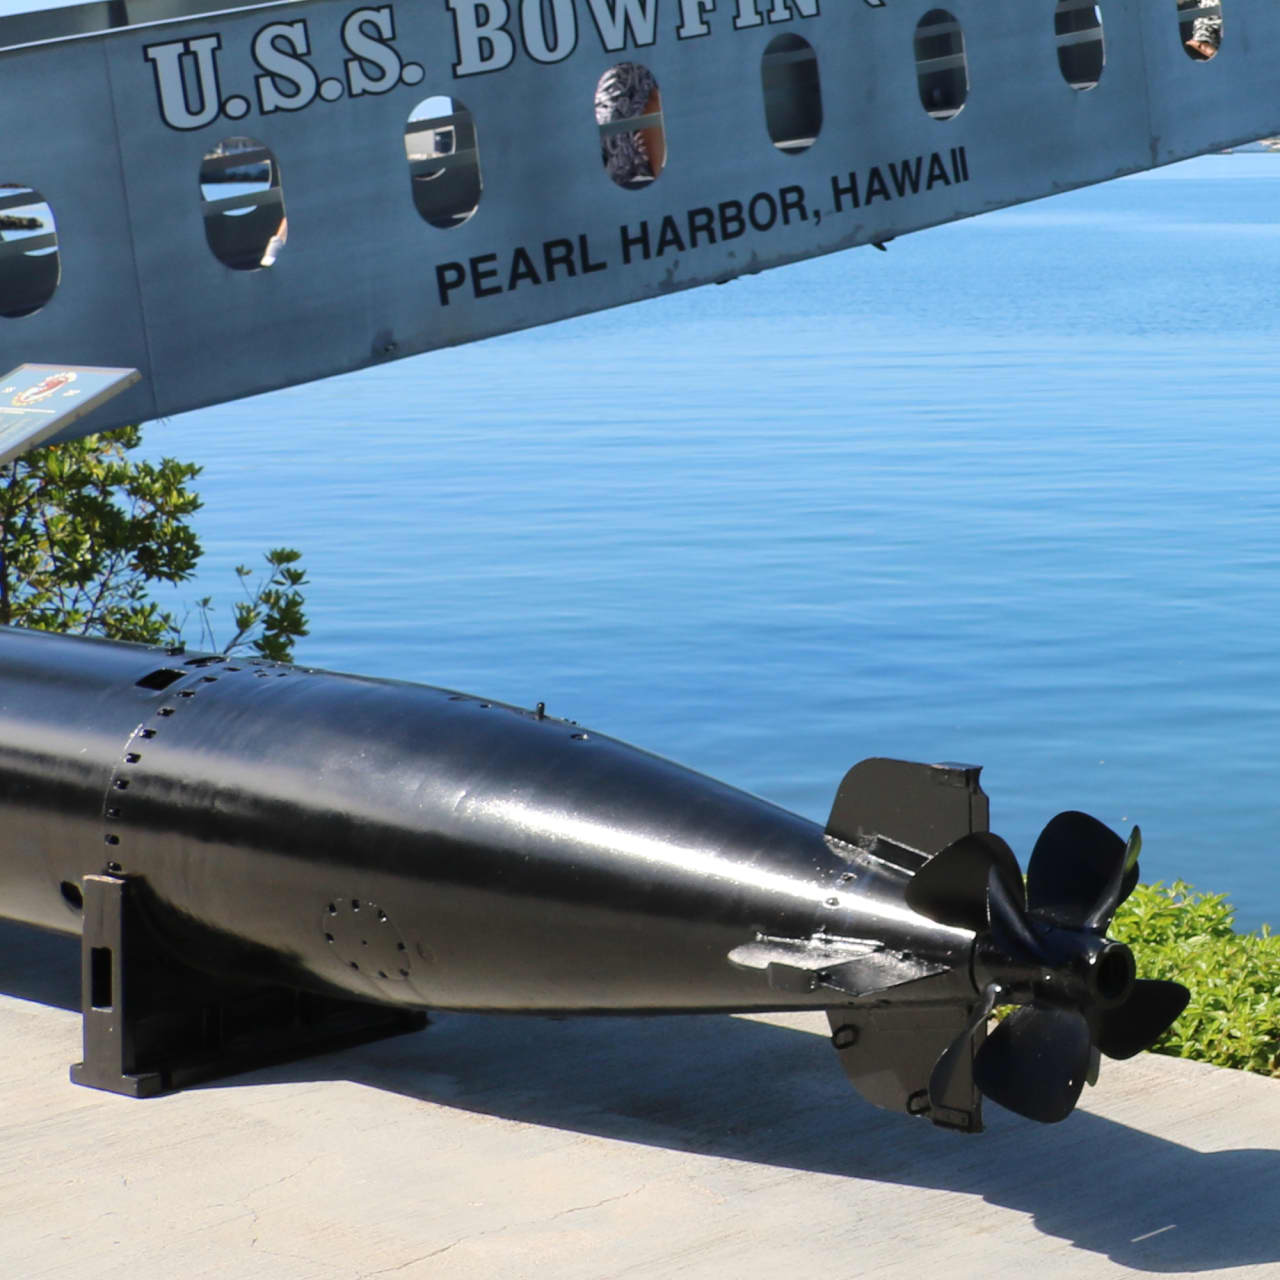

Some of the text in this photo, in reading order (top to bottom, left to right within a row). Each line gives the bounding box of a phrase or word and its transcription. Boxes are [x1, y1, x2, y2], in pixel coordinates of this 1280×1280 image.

[143, 4, 425, 132] U.S.S.
[436, 146, 970, 306] PEARL HARBOR, HAWAII
